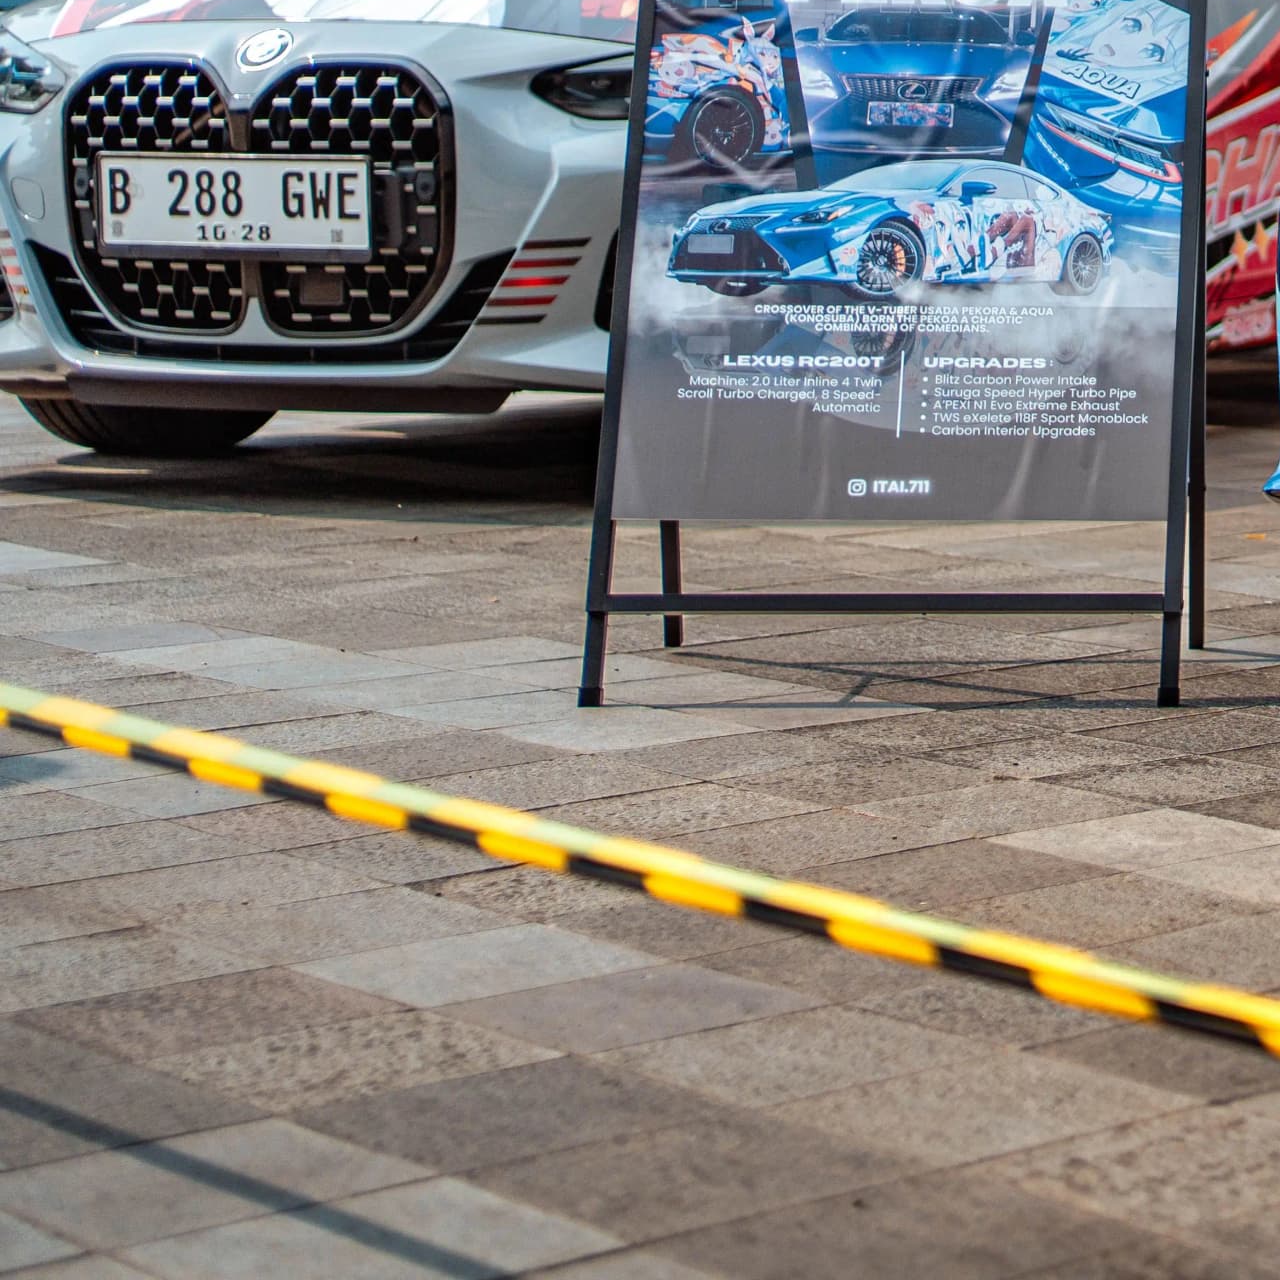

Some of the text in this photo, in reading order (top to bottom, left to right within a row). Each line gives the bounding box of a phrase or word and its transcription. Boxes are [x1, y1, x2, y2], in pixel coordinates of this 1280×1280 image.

[1061, 63, 1141, 100] AQUA
[108, 168, 361, 220] B 288 GWE
[754, 305, 1054, 316] CROSSOVER OF THE V-TUBER USADA PEKORA & AQUA
[785, 314, 1023, 324] (KONOSUBA) BORN THE PEKOA A CHAOTIC
[815, 323, 990, 333] COMBINATION OF COMEDIANS.
[723, 355, 884, 368] LEXUS RC200T
[689, 376, 882, 387] Machine: 2.0 Liter Inline 4 Twin
[935, 375, 1097, 385] Blitz Carbon Power Intake
[678, 389, 881, 402] Scroll Turbo Charged, 8 Speed-
[934, 388, 1137, 401] Suruga Speed Hyper Turbo Pipe
[812, 402, 881, 413] Automatic
[990, 401, 1013, 410] Evo
[1016, 401, 1067, 411] Extreme
[1070, 401, 1120, 411] Exhaust
[933, 413, 960, 423] TWS
[1041, 414, 1075, 425] Sport
[1078, 414, 1148, 424] Monoblock
[931, 425, 1096, 439] Carbon Interior Upgrades
[873, 480, 930, 493] ITAI.711
